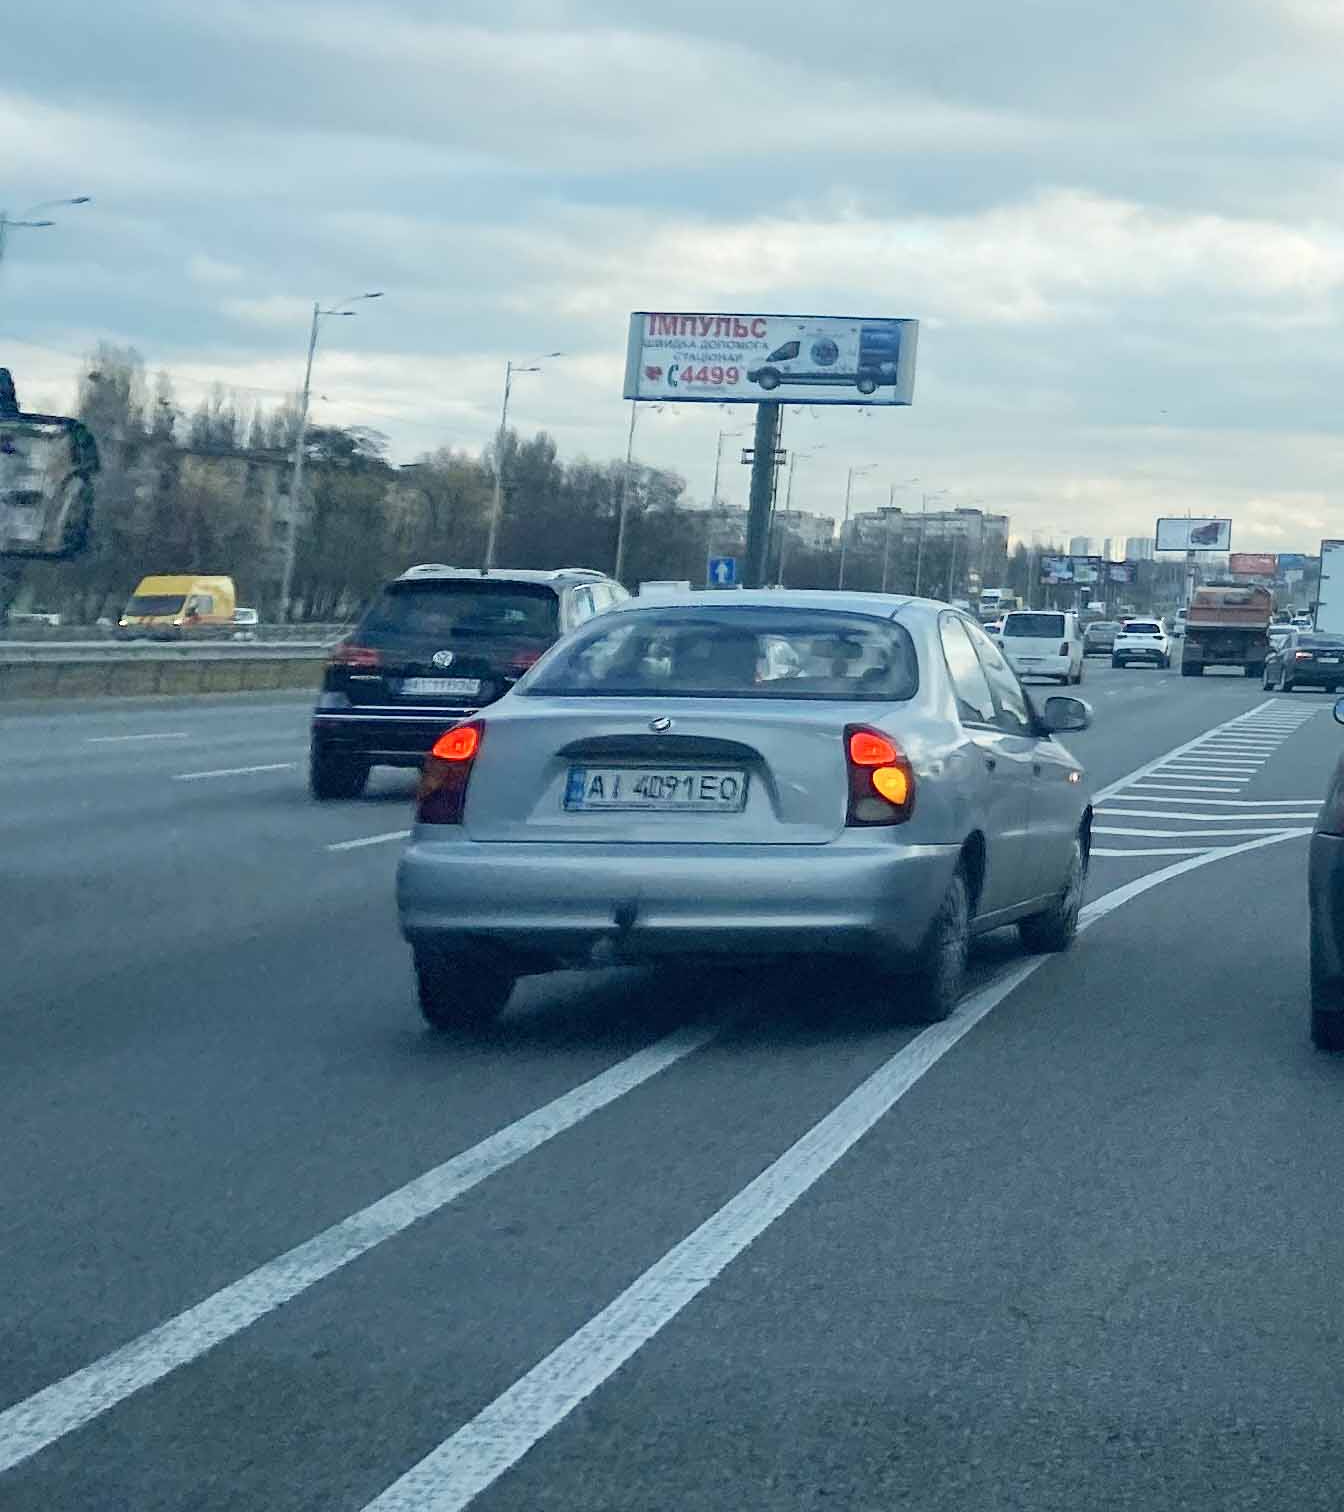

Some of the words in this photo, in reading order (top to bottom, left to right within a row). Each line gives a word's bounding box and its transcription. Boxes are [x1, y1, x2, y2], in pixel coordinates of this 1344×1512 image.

[649, 315, 767, 338] ІМПУЛЬС
[679, 365, 740, 385] 4499
[587, 774, 621, 799] AI
